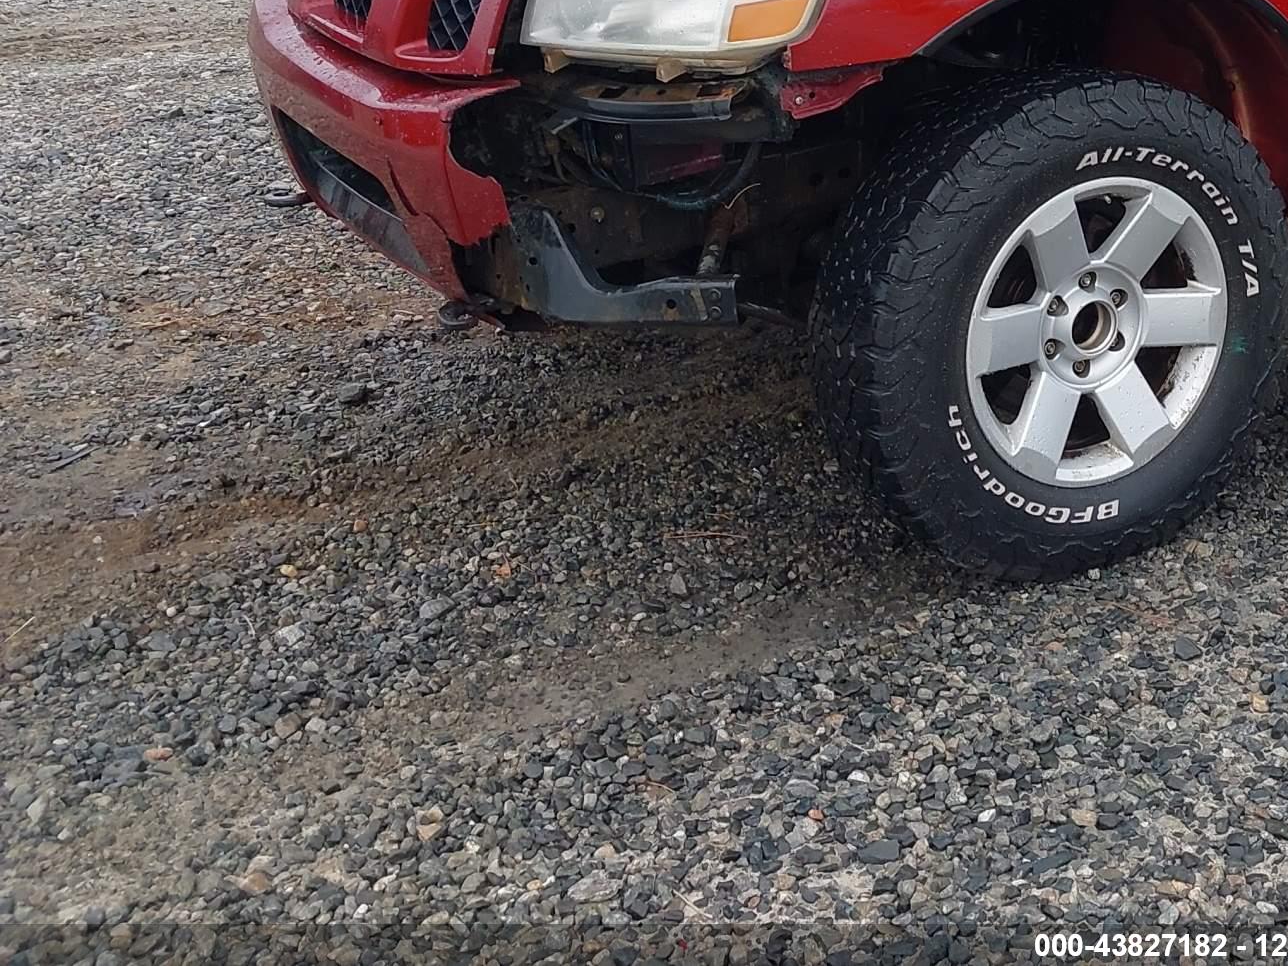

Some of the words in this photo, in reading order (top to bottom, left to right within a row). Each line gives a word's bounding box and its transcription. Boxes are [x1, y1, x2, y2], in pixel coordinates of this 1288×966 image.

[1075, 146, 1241, 226] All-Terrain
[1236, 239, 1260, 299] T/A
[946, 404, 1121, 524] BFGoodrich
